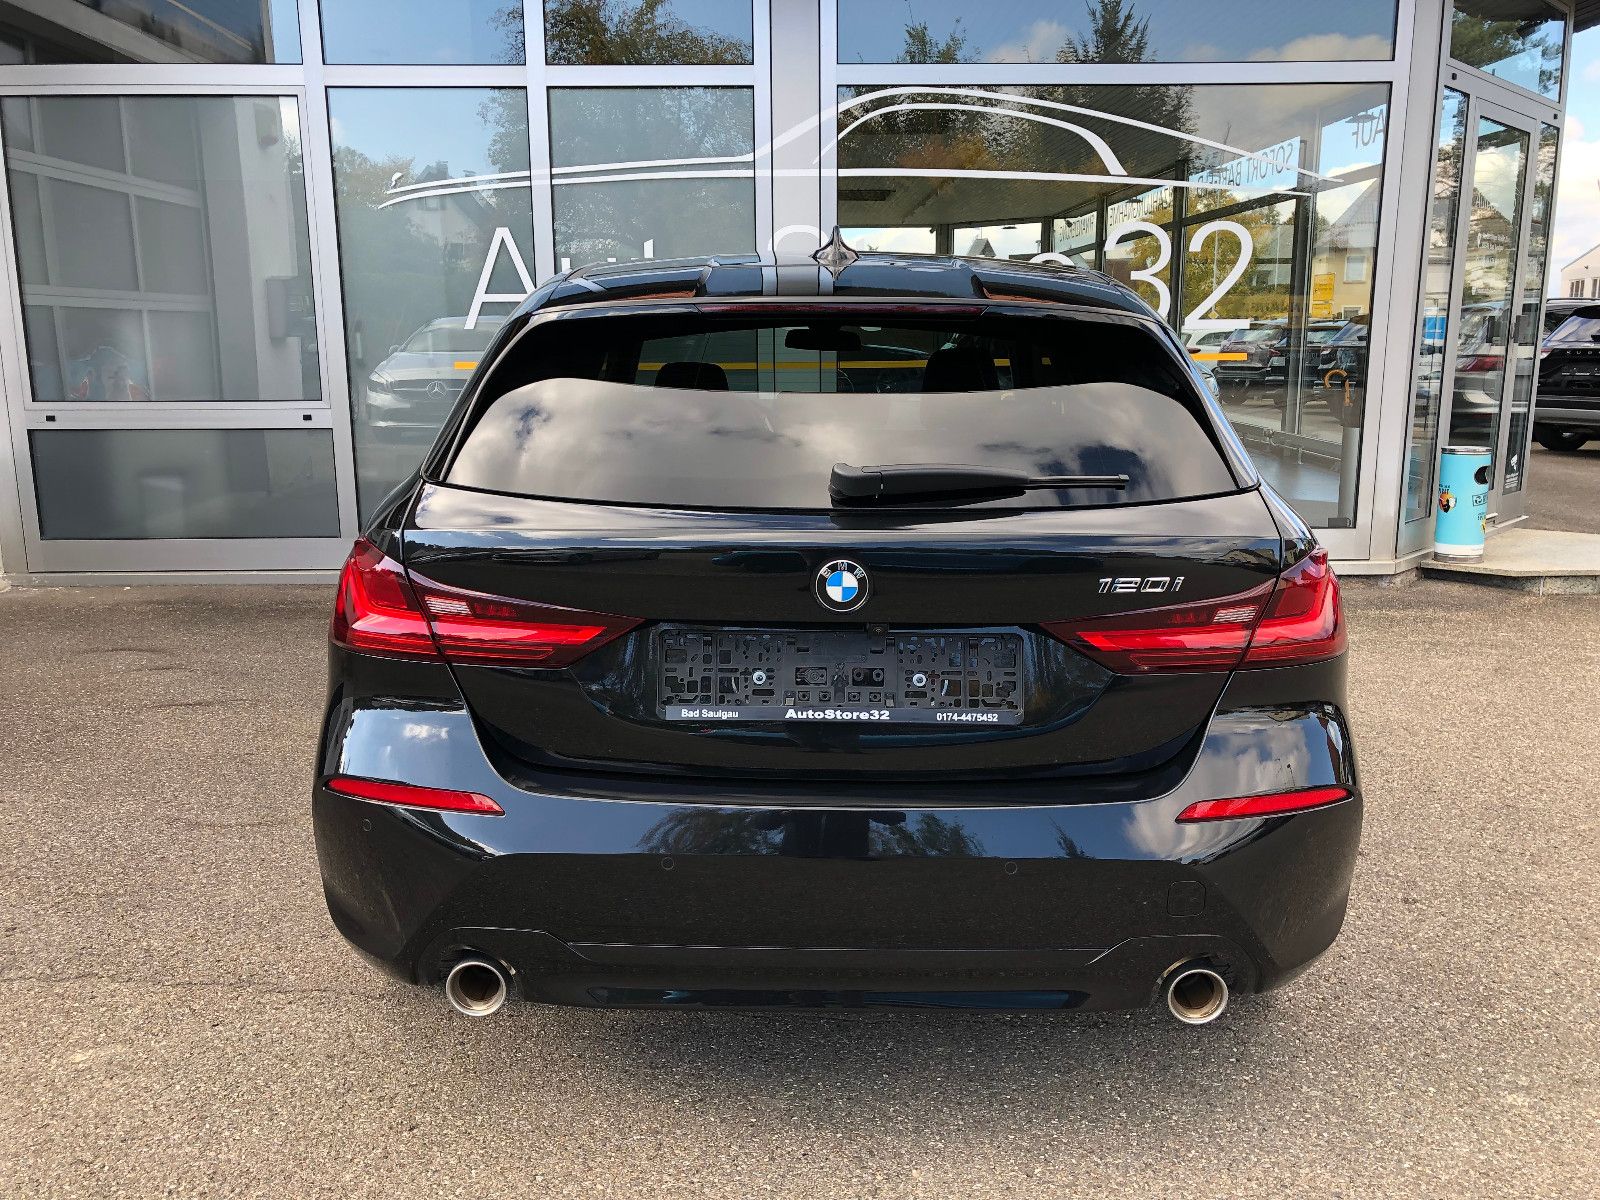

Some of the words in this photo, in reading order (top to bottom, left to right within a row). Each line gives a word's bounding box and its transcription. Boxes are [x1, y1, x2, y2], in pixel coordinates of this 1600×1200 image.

[820, 561, 865, 580] BMW
[1098, 576, 1185, 594] 120i
[681, 709, 699, 718] Bad
[701, 710, 739, 719] Saulgau
[784, 709, 890, 720] AutoStore32
[936, 713, 999, 722] 0174-4475452
